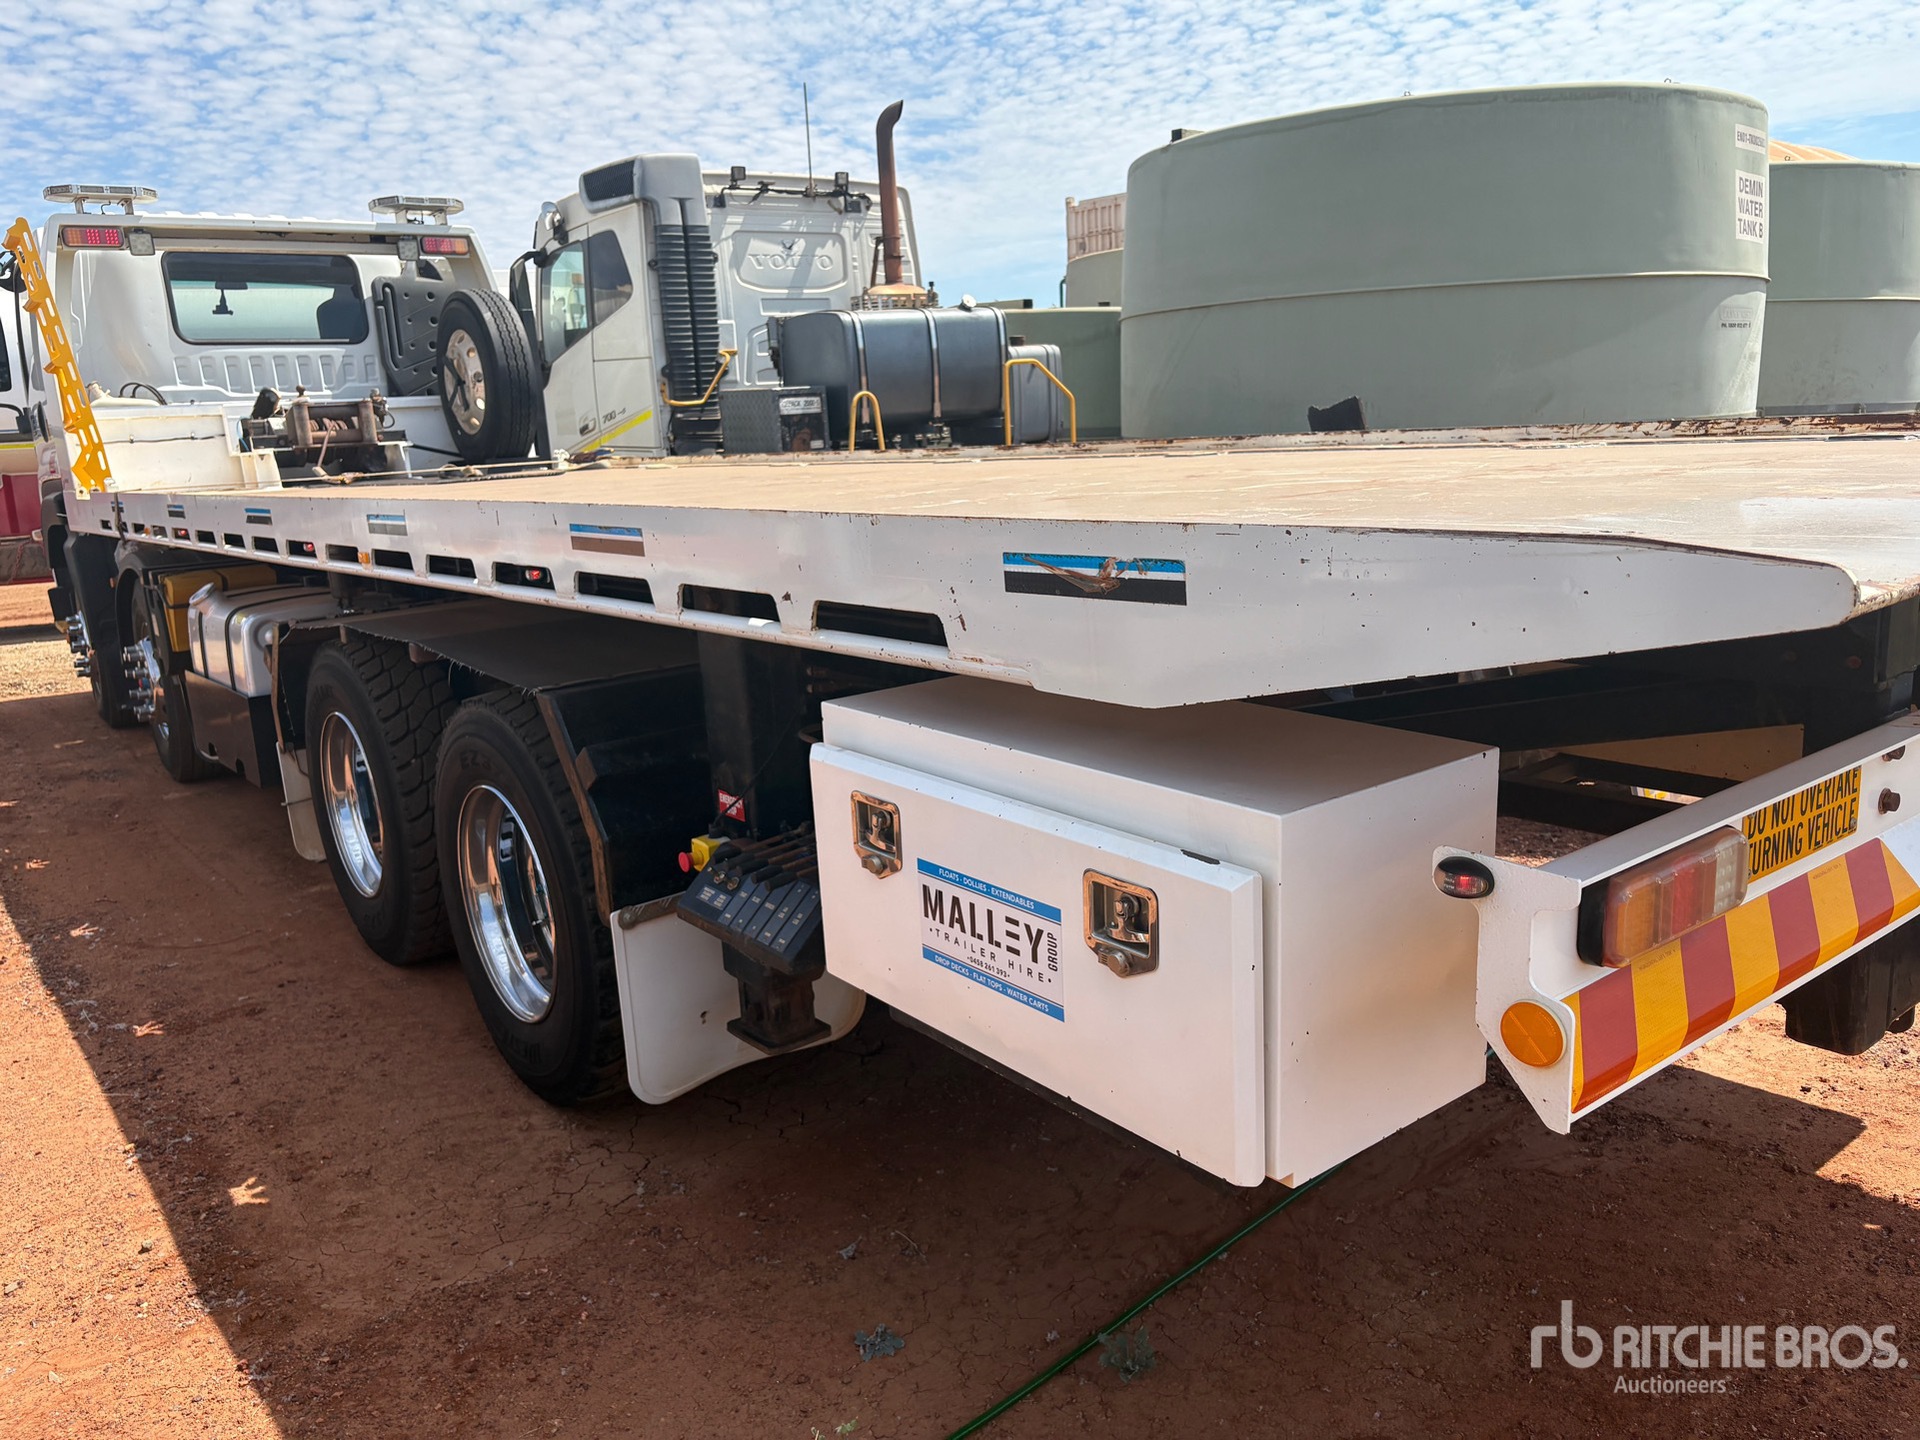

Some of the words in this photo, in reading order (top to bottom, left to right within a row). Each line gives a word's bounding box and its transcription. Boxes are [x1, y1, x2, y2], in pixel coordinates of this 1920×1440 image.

[1738, 176, 1764, 198] DEMIN
[1738, 197, 1764, 218] WATER
[1737, 218, 1758, 237] TANK
[1758, 222, 1764, 238] B
[747, 253, 834, 270] VOLVO
[1747, 807, 1767, 840] DO
[1771, 794, 1796, 830] NOT
[1800, 768, 1858, 817] OVERTAKE
[1749, 821, 1804, 875] URNING
[1807, 796, 1857, 850] VEHICLE
[938, 868, 959, 882] FLOATS
[963, 877, 987, 892] DOLLIES
[991, 887, 1035, 910] EXTENDABLES
[922, 883, 1045, 964] MALLEY
[935, 928, 996, 962] TRAILER
[1008, 959, 1044, 983] HIRE
[1046, 932, 1059, 972] GROUP
[934, 955, 950, 966] DROP
[950, 962, 970, 976] DECKS
[973, 972, 986, 984] FLAT
[987, 979, 1003, 991] TOPS
[1006, 987, 1028, 1003] WATER
[1028, 998, 1049, 1012] CARTS
